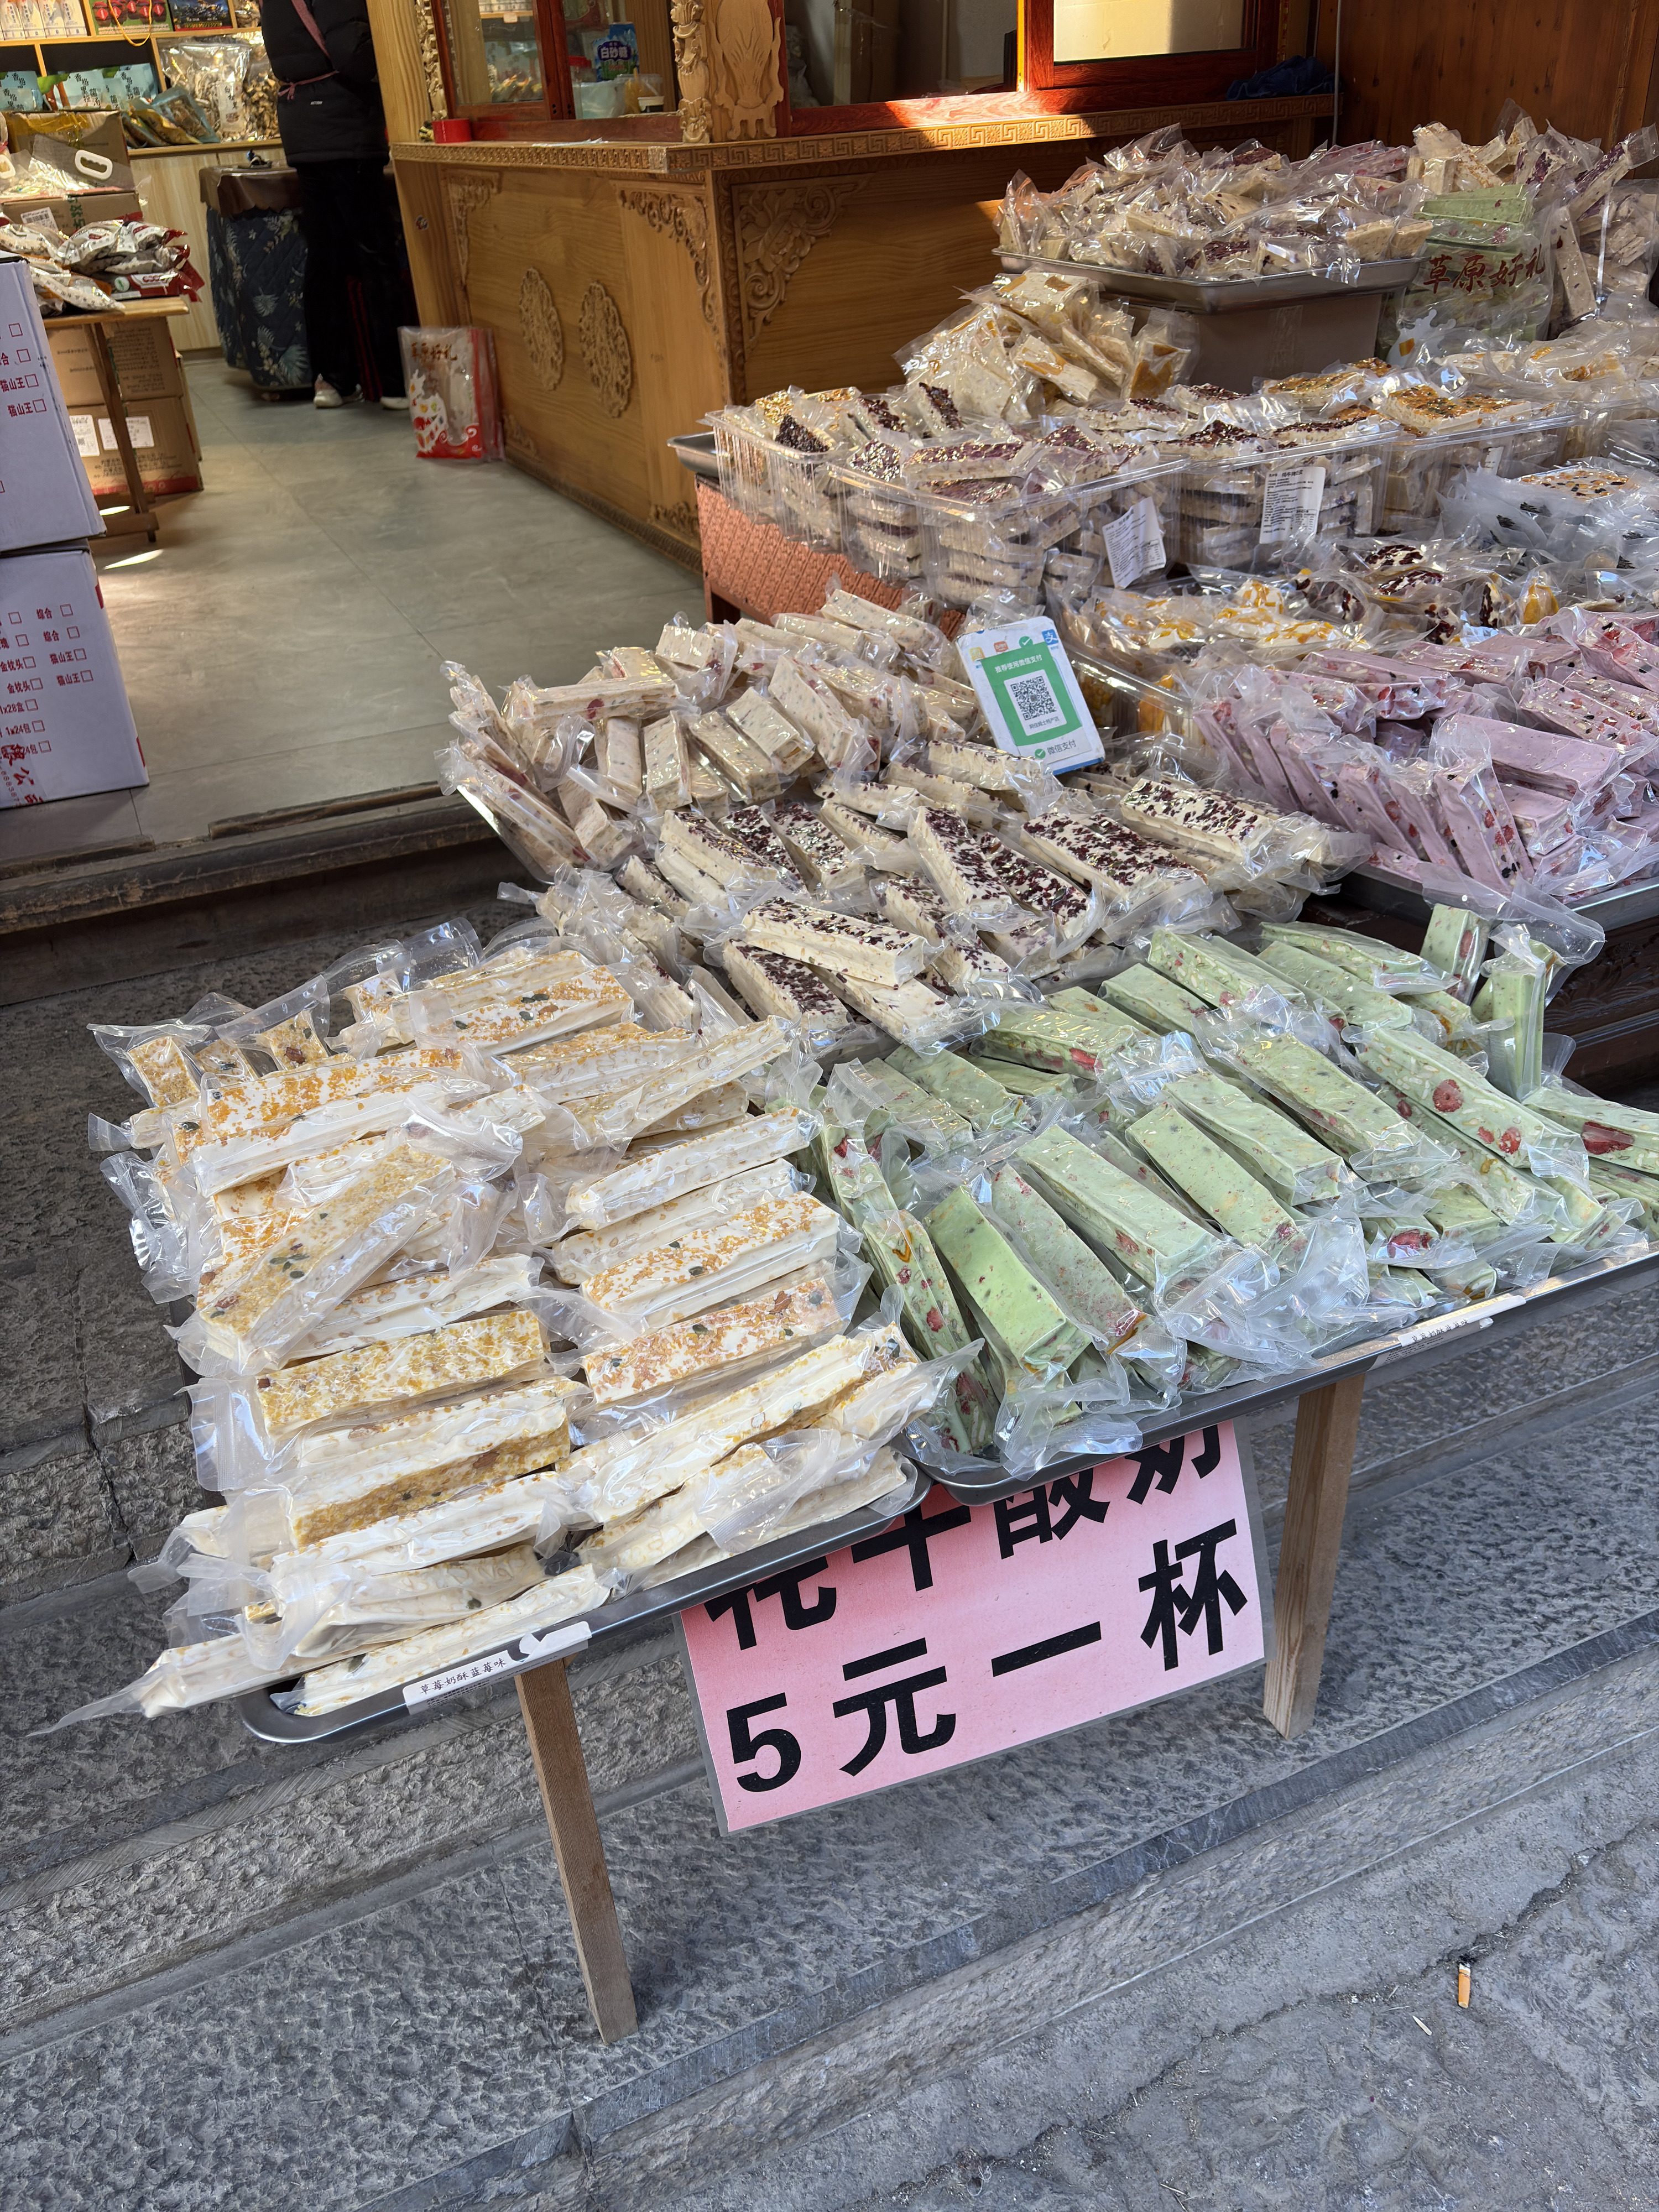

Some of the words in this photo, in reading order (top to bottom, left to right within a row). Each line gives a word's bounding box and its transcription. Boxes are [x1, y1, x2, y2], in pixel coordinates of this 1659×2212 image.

[601, 46, 628, 59] 白砂糖
[1423, 243, 1546, 294] 草原好礼
[0, 377, 25, 393] 猫山王
[7, 401, 33, 418] 猫山王
[36, 607, 53, 620] 综合
[43, 630, 60, 642] 综合
[0, 659, 24, 672] 金枕头
[995, 654, 1043, 674] 推荐使用微信支付
[7, 680, 31, 694] 金枕头
[1047, 739, 1076, 755] 微信支付
[726, 1517, 1248, 1793] 5元一杯
[420, 1657, 507, 1695] 草莓奶酥蓝莓味
